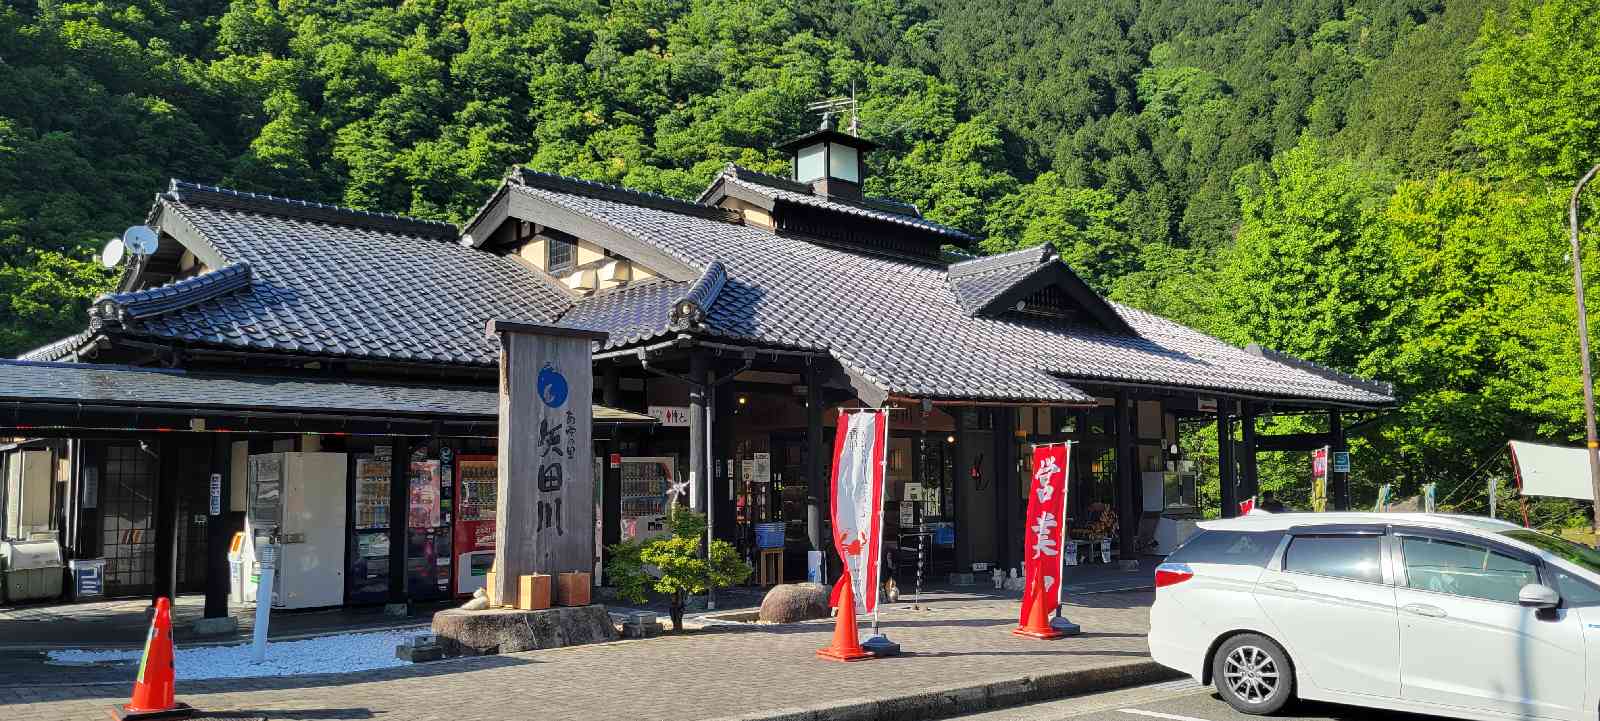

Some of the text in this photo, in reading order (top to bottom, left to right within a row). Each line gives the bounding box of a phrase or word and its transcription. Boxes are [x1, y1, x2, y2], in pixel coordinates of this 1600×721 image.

[537, 419, 564, 537] 矢田川
[1031, 456, 1061, 592] 営業
